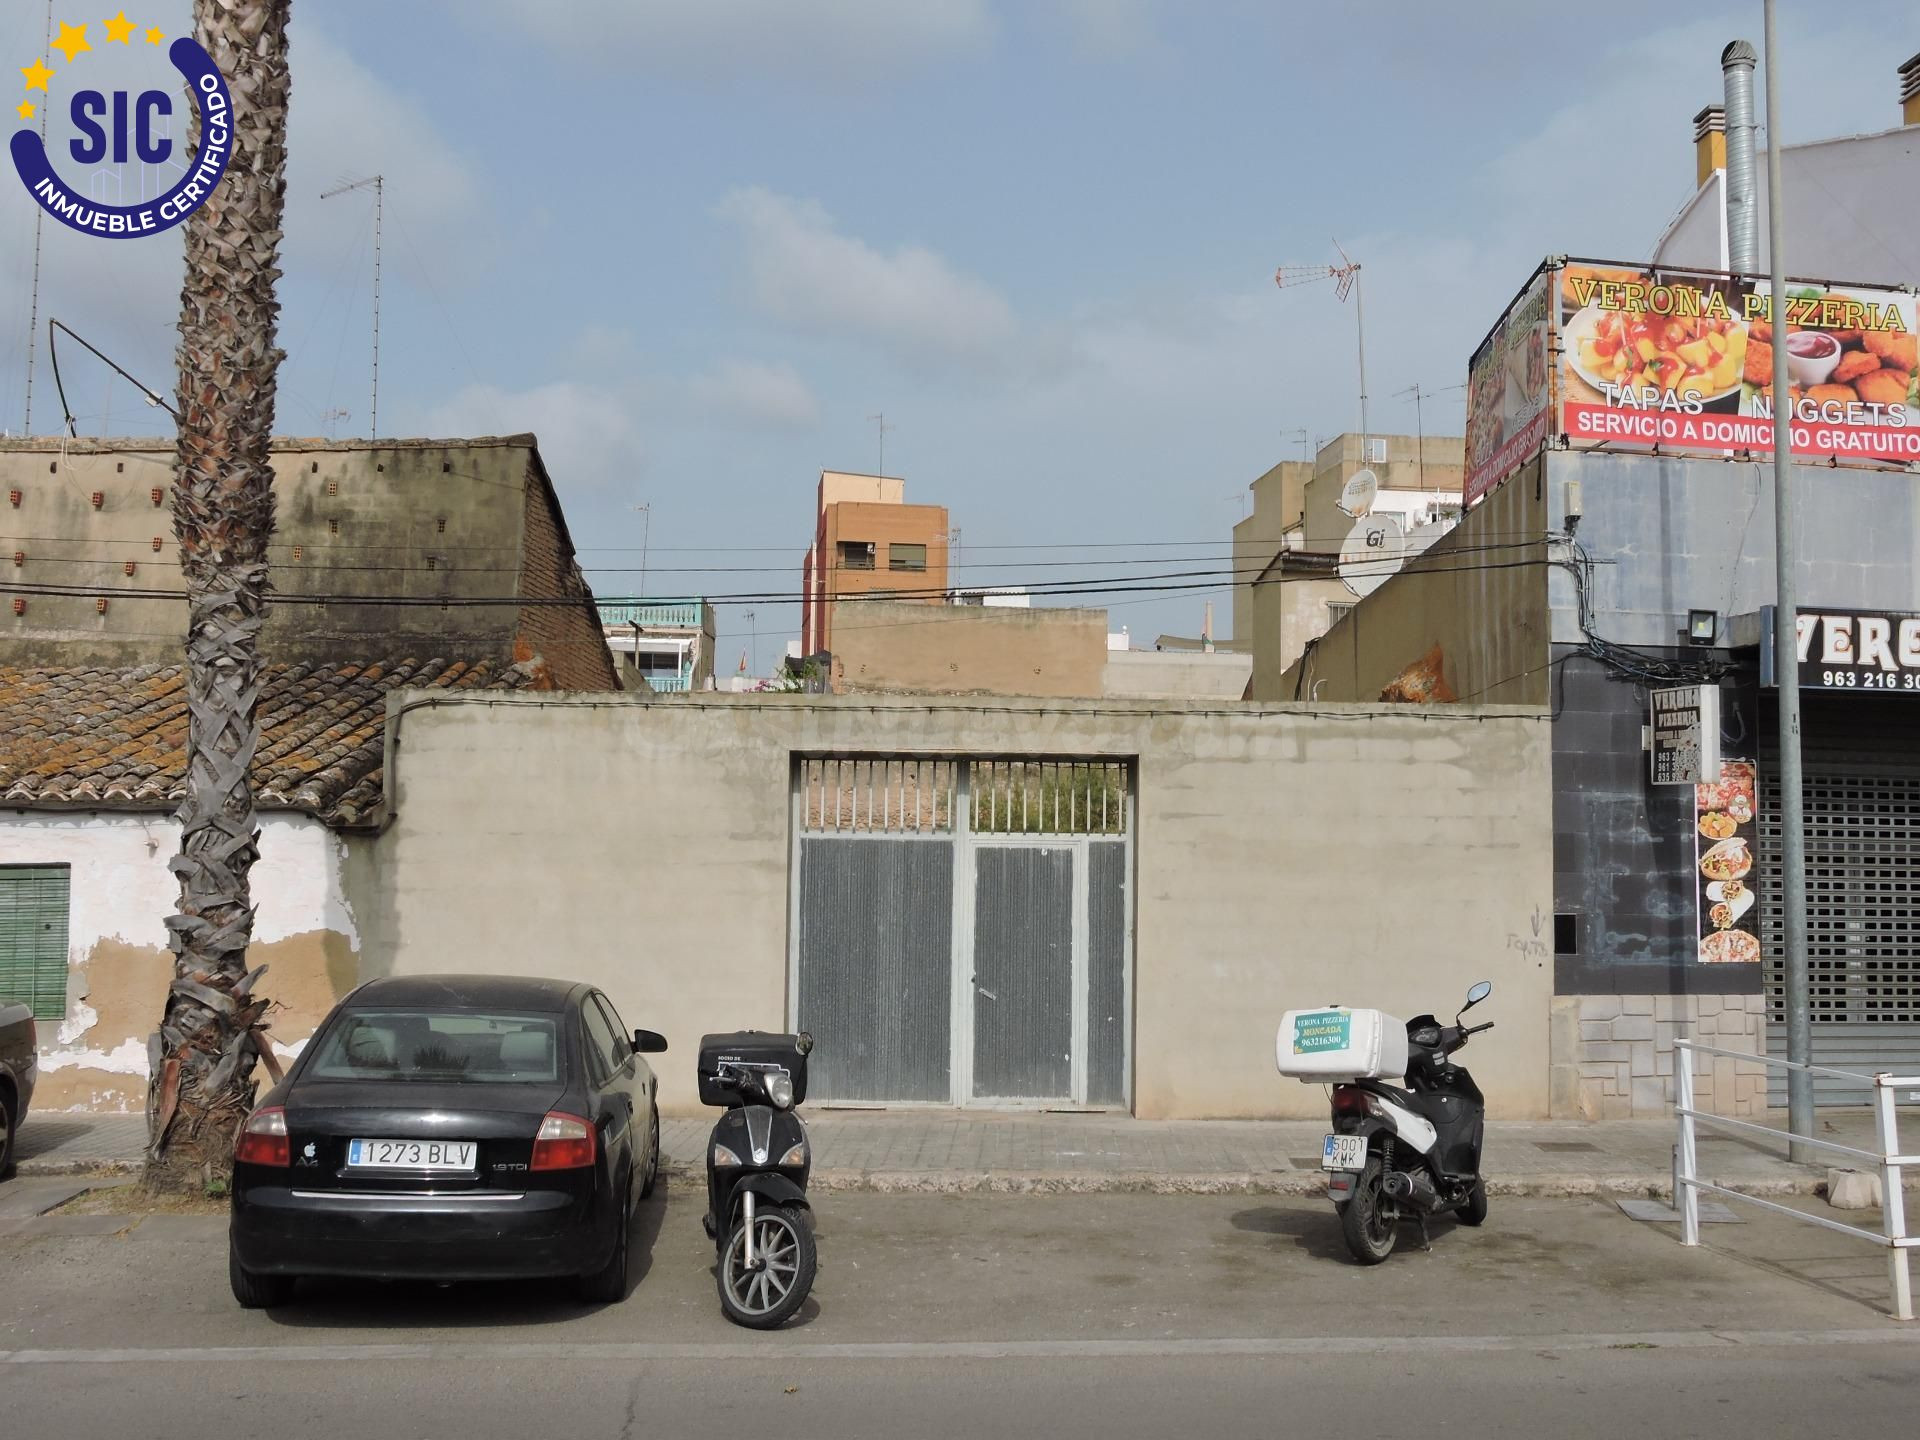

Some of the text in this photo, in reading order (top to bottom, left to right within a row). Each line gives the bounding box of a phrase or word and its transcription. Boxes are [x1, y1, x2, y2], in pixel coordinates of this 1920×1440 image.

[1570, 277, 1732, 320] VERONA
[1600, 382, 1907, 428] TAPAS NGGETS
[1578, 411, 1677, 437] SERVICIO
[1682, 420, 1698, 440] A
[1816, 429, 1920, 454] GRATUITO
[1823, 671, 1856, 687] 963
[1863, 672, 1896, 688] 216
[368, 1143, 471, 1165] 1273 BLV
[1333, 1138, 1364, 1152] 5001
